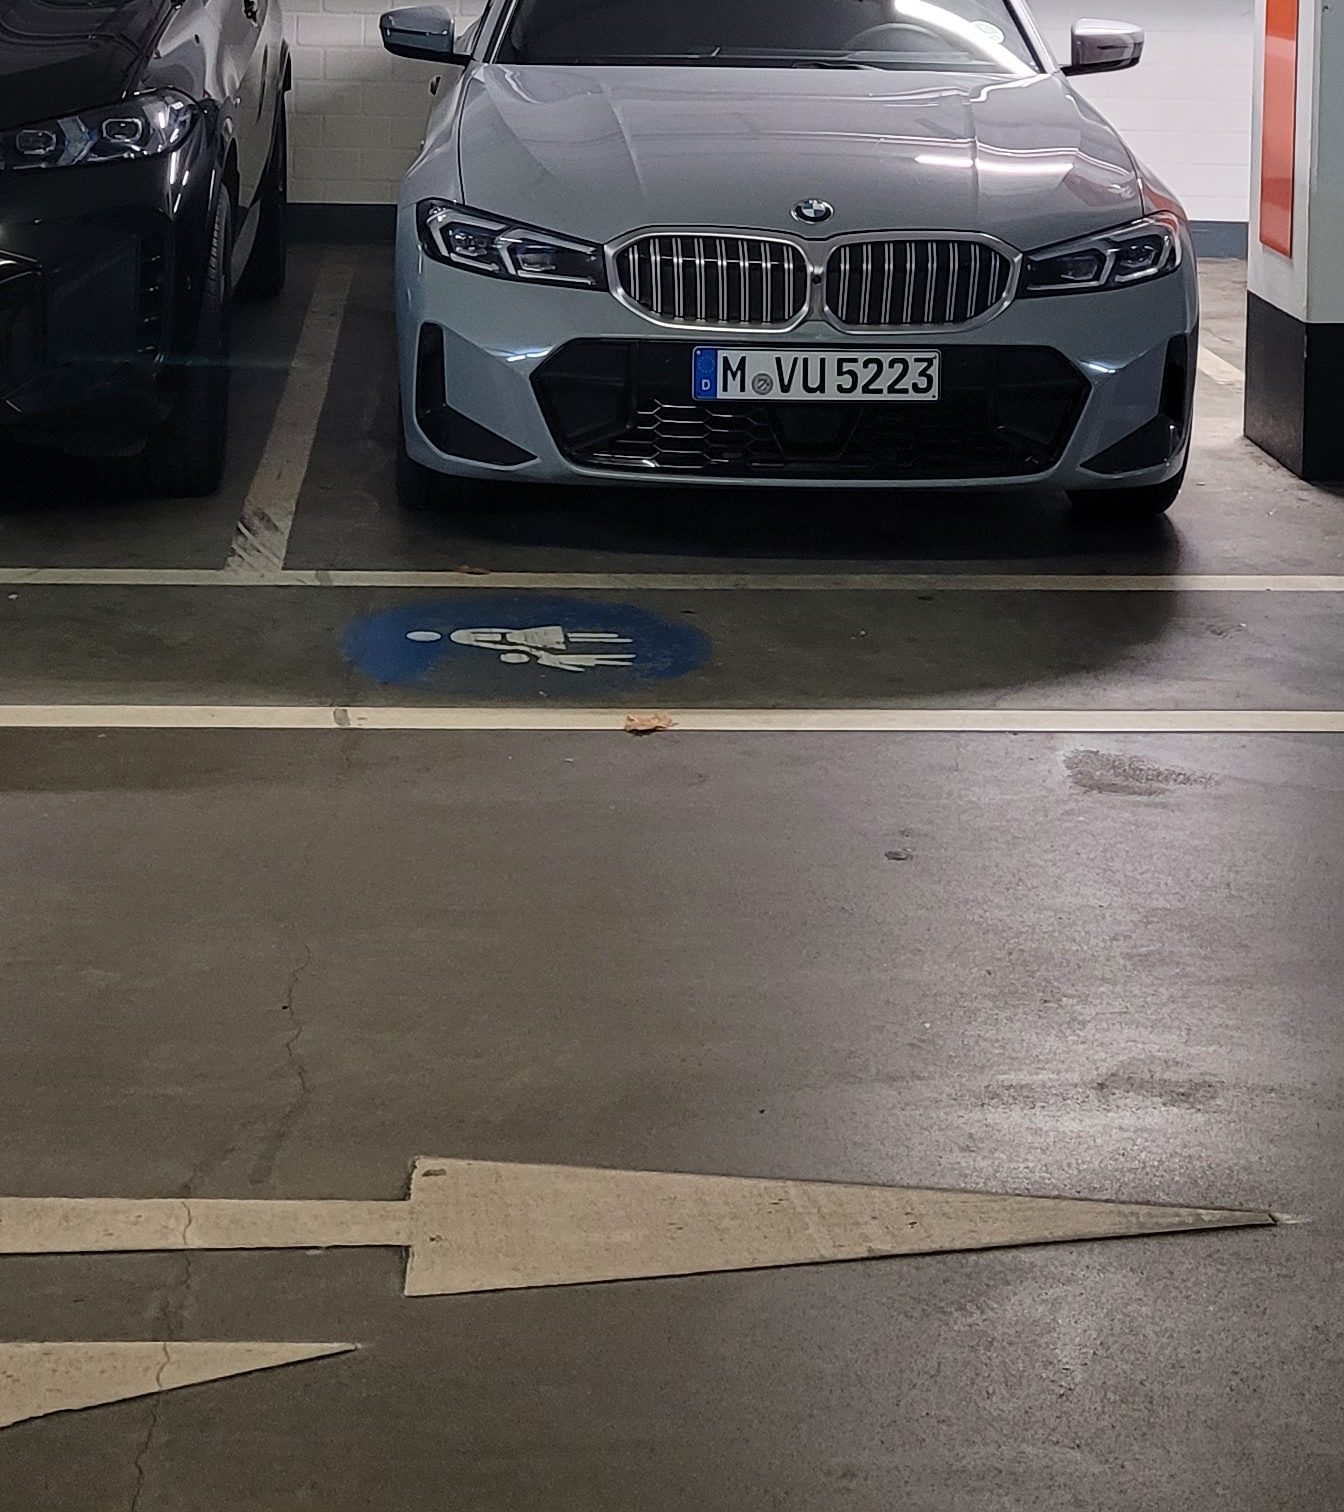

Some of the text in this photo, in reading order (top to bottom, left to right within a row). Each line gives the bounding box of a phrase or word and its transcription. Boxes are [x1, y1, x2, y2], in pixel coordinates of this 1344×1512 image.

[701, 355, 934, 395] D M VU 5223
